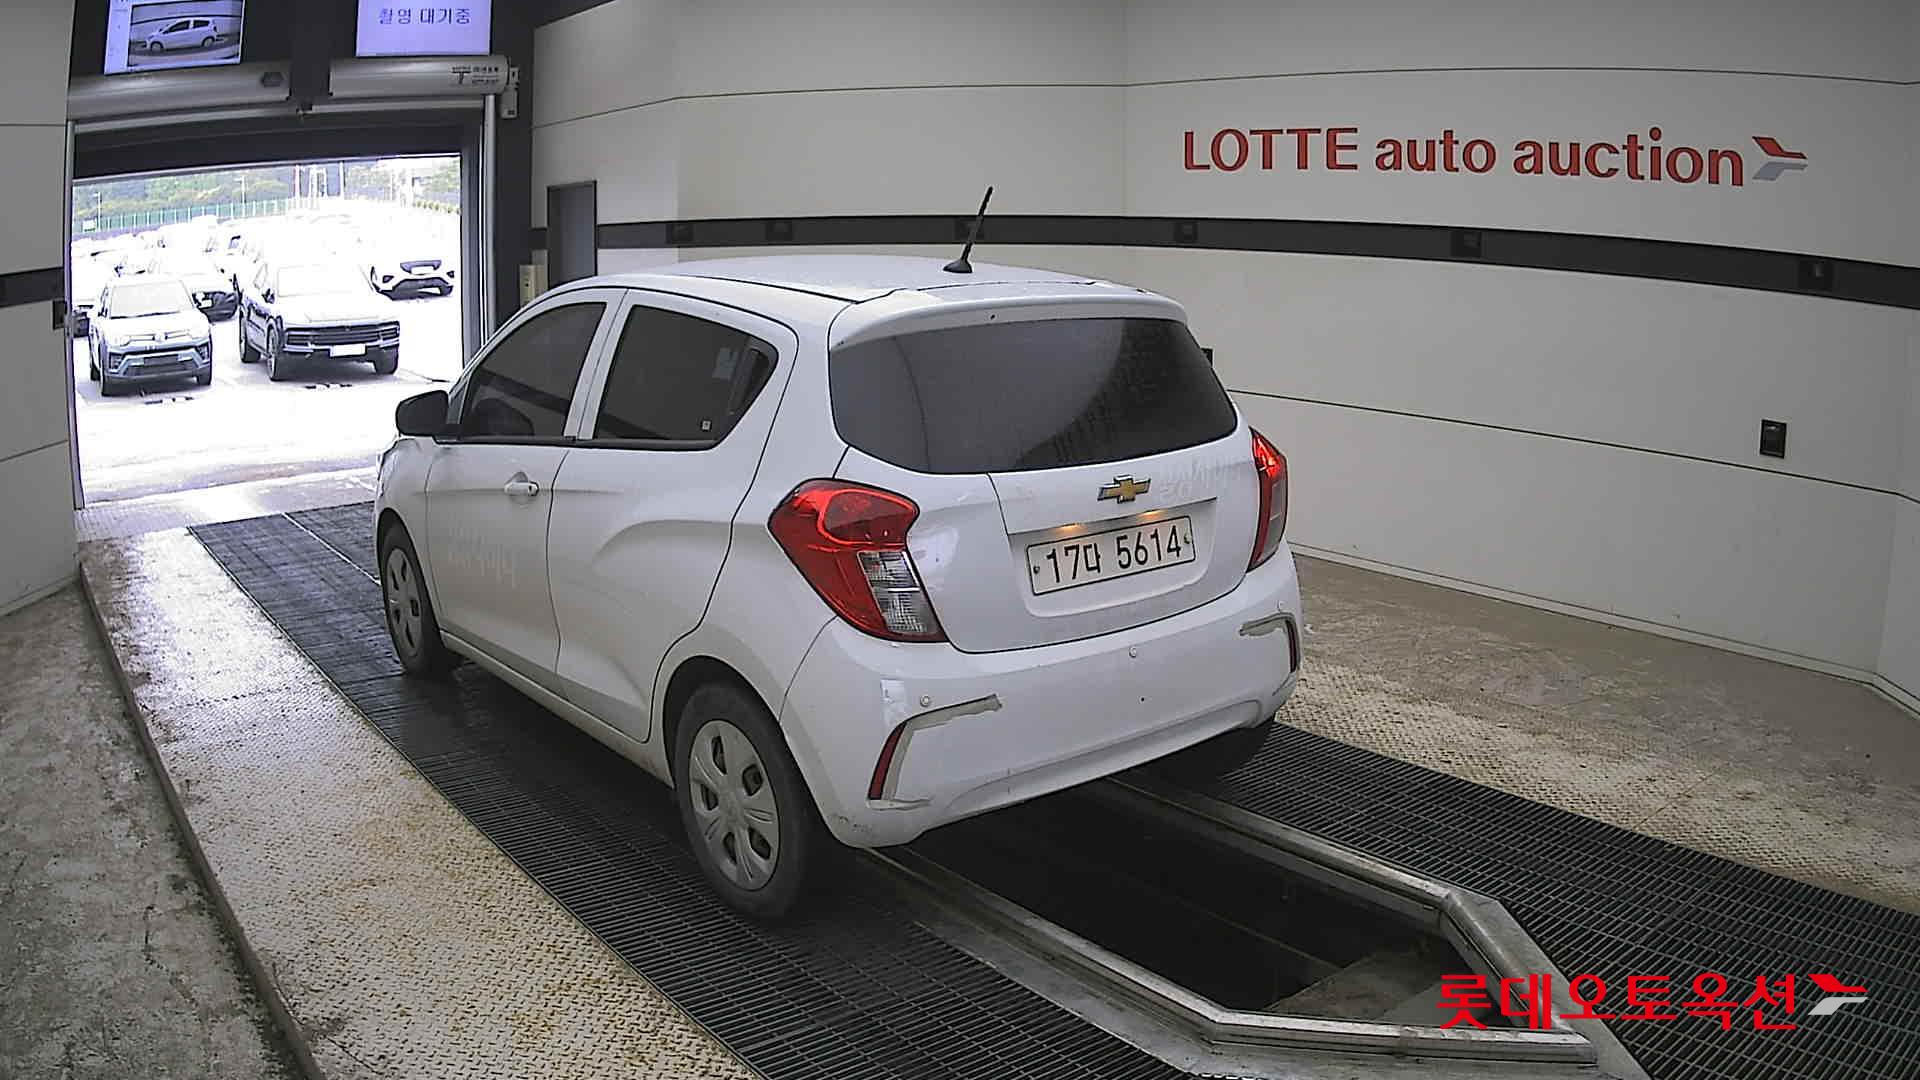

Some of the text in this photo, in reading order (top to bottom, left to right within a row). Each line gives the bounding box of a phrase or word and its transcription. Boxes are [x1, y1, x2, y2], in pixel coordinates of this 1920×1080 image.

[420, 8, 471, 25] 대기중
[1184, 126, 1743, 185] LOTTE auto auction
[1115, 525, 1182, 570] 5614
